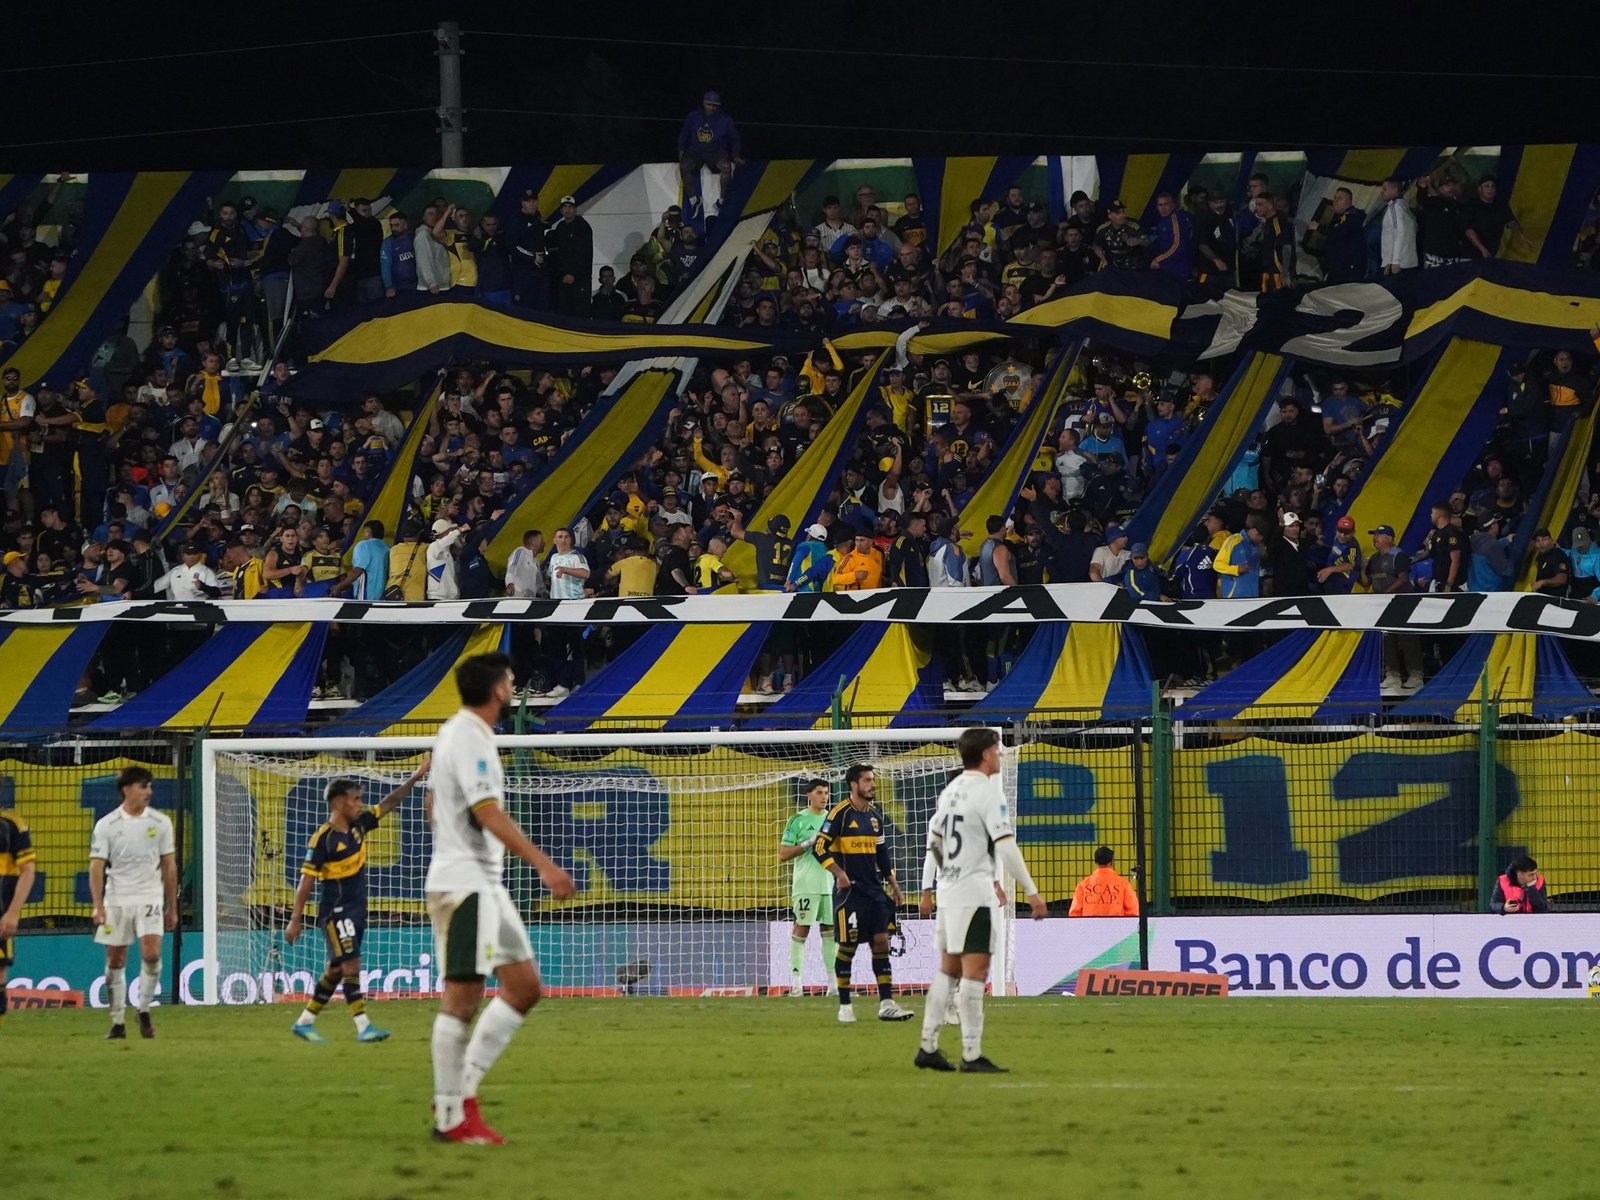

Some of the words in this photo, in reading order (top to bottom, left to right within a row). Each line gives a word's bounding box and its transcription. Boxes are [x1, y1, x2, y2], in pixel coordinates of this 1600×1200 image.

[932, 402, 950, 414] 12
[772, 541, 793, 566] 12
[1206, 750, 1528, 886] 12
[941, 813, 965, 861] 15
[1085, 883, 1120, 896] SCAS
[145, 904, 161, 917] 24
[798, 898, 811, 911] 12
[847, 911, 858, 929] 4
[1175, 939, 1367, 991] Banco
[1387, 937, 1462, 991] de
